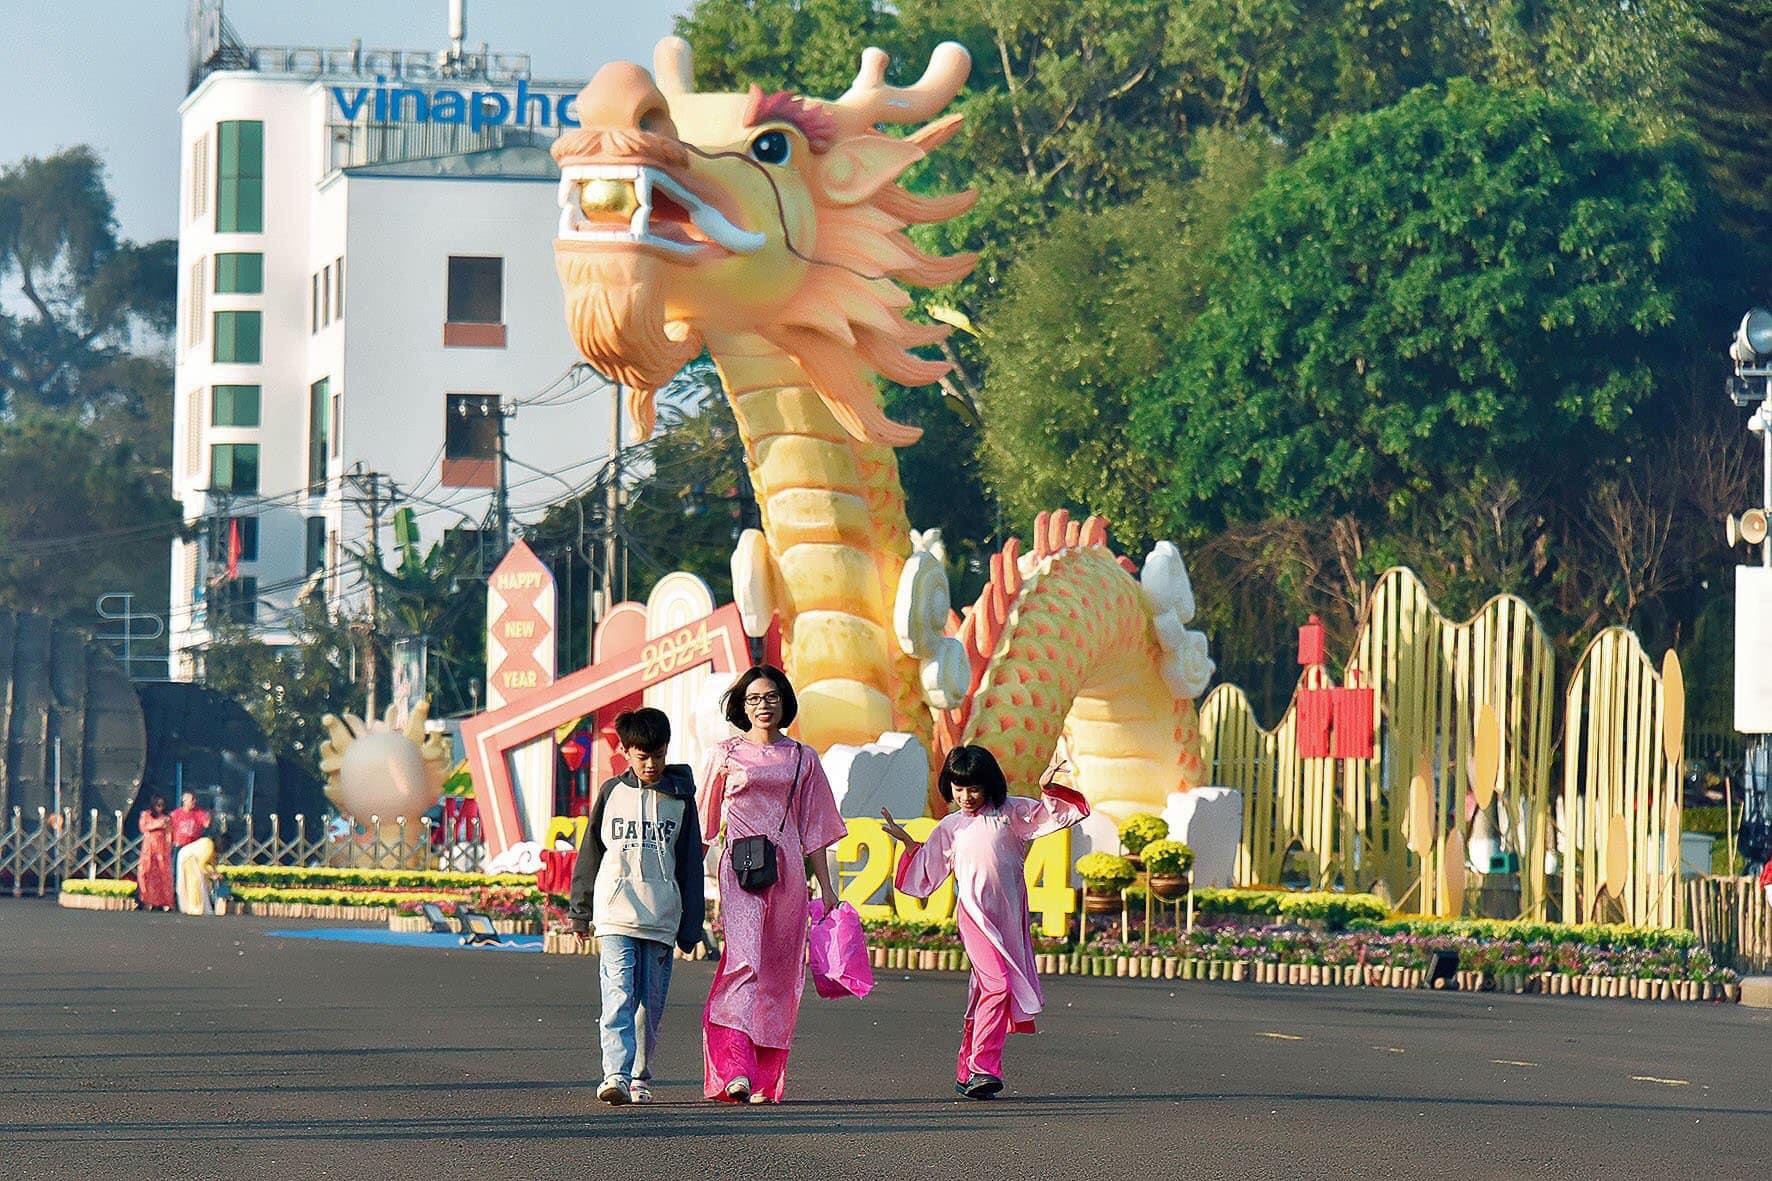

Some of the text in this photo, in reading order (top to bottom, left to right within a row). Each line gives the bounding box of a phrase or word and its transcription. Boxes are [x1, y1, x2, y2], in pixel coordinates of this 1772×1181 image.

[496, 571, 543, 590] HAPPY
[504, 620, 536, 638] NEW
[641, 620, 712, 681] 2024
[502, 670, 537, 688] YEAR
[836, 817, 1075, 937] 204
